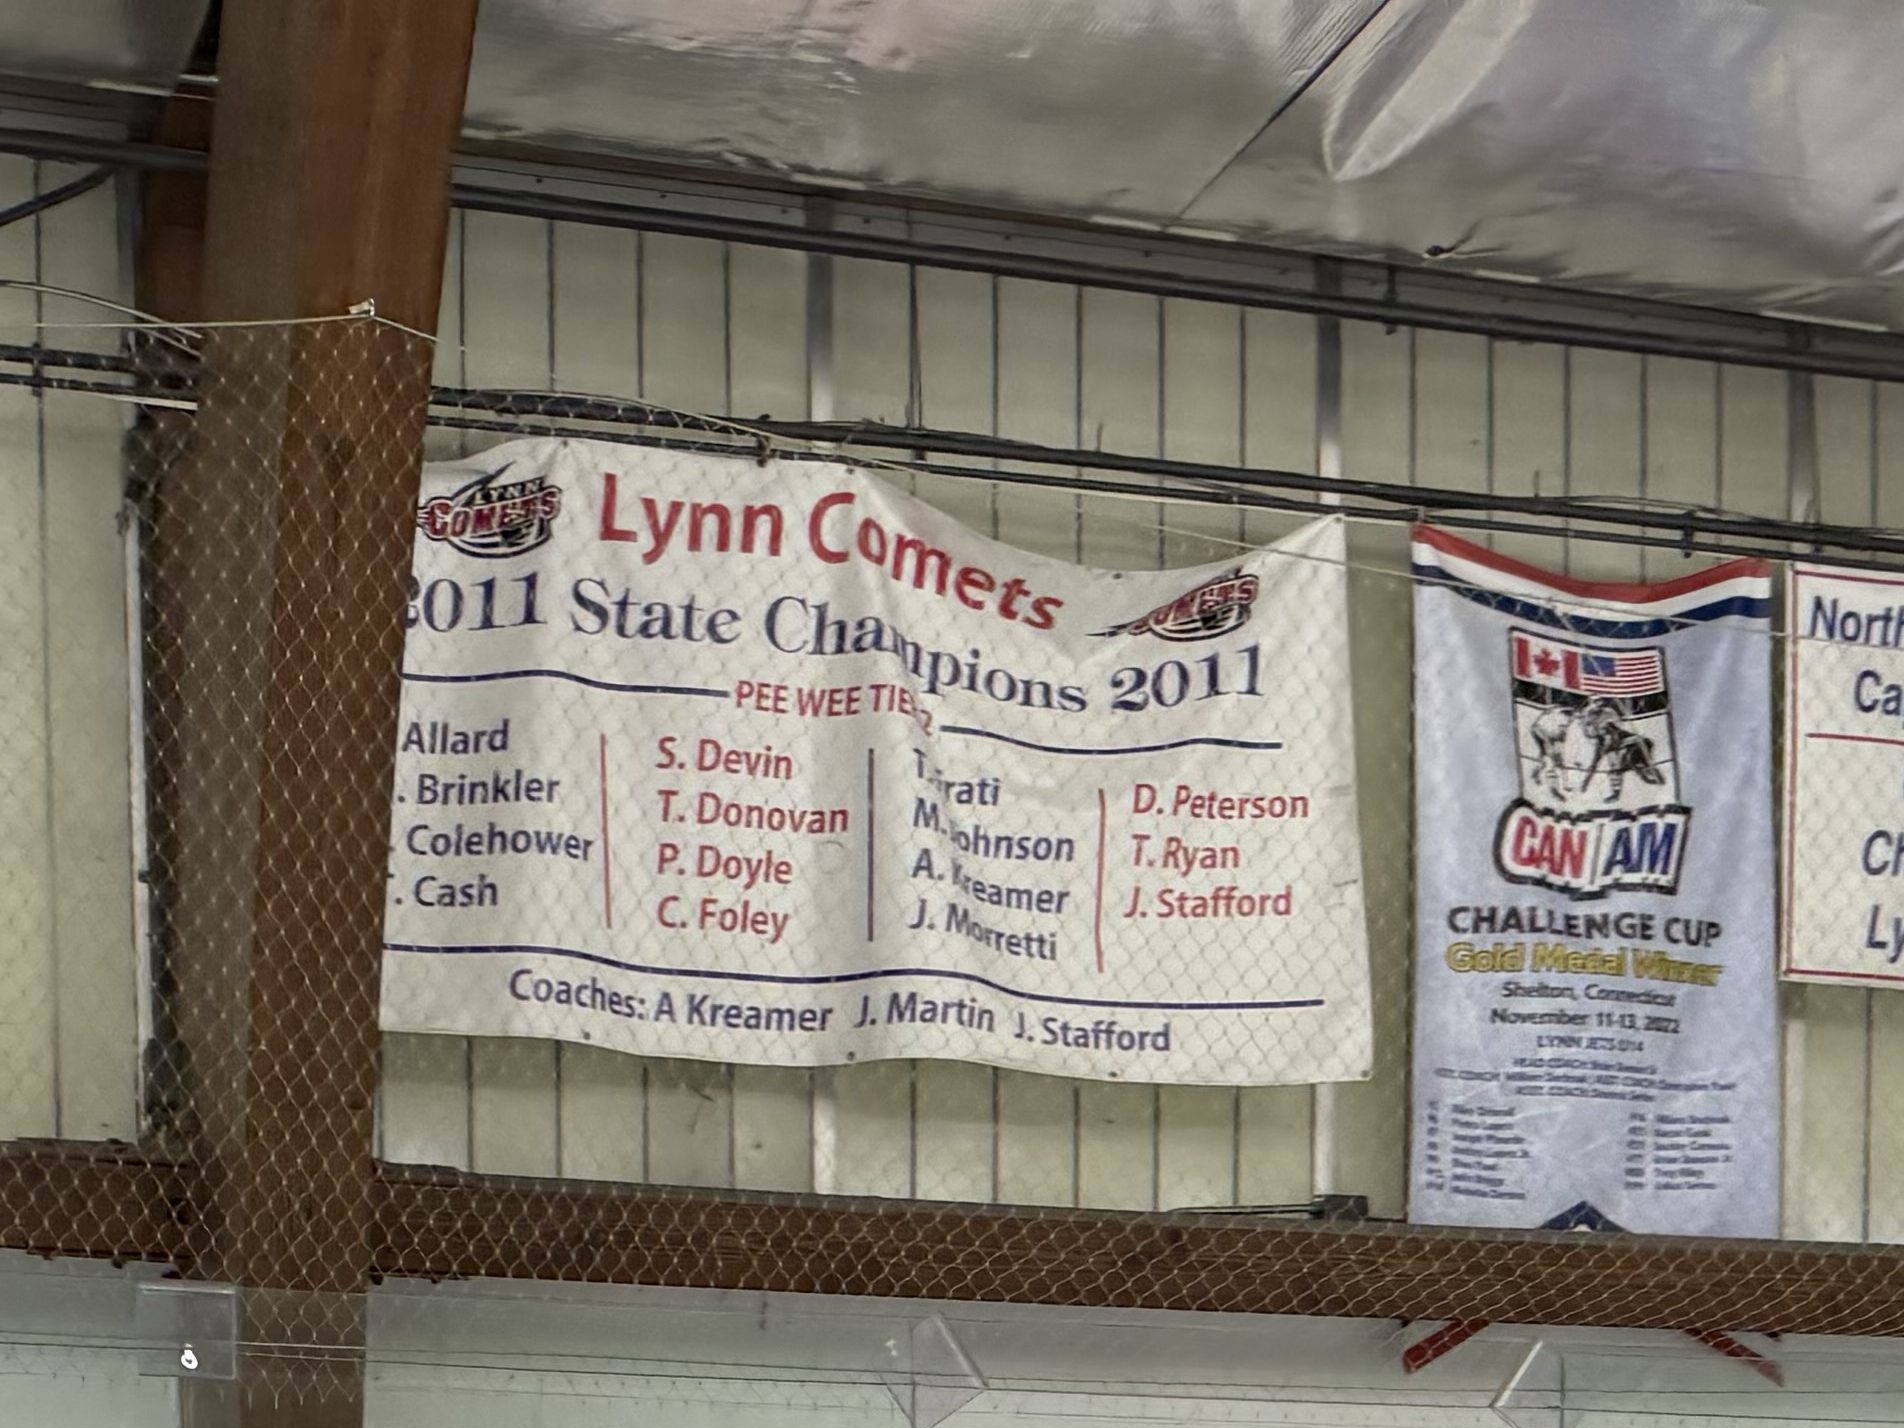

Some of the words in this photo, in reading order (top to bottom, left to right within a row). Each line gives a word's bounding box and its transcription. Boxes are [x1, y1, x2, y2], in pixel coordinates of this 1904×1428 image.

[600, 472, 784, 565] Lynn
[807, 491, 1065, 631] Comets
[571, 577, 742, 644] State
[763, 595, 1088, 713] Champions
[1109, 642, 1265, 713] 2011
[734, 680, 789, 714] PEE
[798, 686, 861, 717] WEE
[401, 719, 510, 756] Allard
[656, 736, 686, 771] S.
[697, 738, 794, 781] Devin
[416, 769, 561, 807] Brinkler
[1132, 783, 1165, 815] D.
[1172, 783, 1310, 822] Peterson
[657, 789, 685, 823] T.
[696, 791, 850, 836] Donovan
[405, 822, 595, 862] Colehower
[1131, 833, 1157, 868] T.
[1162, 836, 1241, 878] Ryan
[1511, 815, 1589, 880] CAN
[1603, 821, 1679, 877] AM
[657, 842, 686, 876] P.
[697, 843, 793, 890] Doyle
[912, 847, 946, 882] A.
[413, 873, 499, 908] Cash
[1123, 885, 1148, 919] J.
[1156, 884, 1293, 920] Stafford
[656, 895, 688, 930] C.
[698, 897, 790, 944] Foley
[908, 904, 936, 932] J.
[946, 902, 1058, 962] Morretti
[1446, 905, 1657, 941] CHALLENGE
[1663, 916, 1723, 948] CUP
[1445, 941, 1525, 974] Gold
[1531, 942, 1626, 978] Medal
[508, 968, 646, 1022] Coaches:
[653, 990, 677, 1025] A
[687, 993, 835, 1034] Kreamer
[853, 995, 878, 1029] J.
[887, 990, 995, 1034] Martin
[1013, 1011, 1035, 1043] J.
[1041, 1015, 1172, 1053] Stafford
[1490, 1007, 1590, 1028] November
